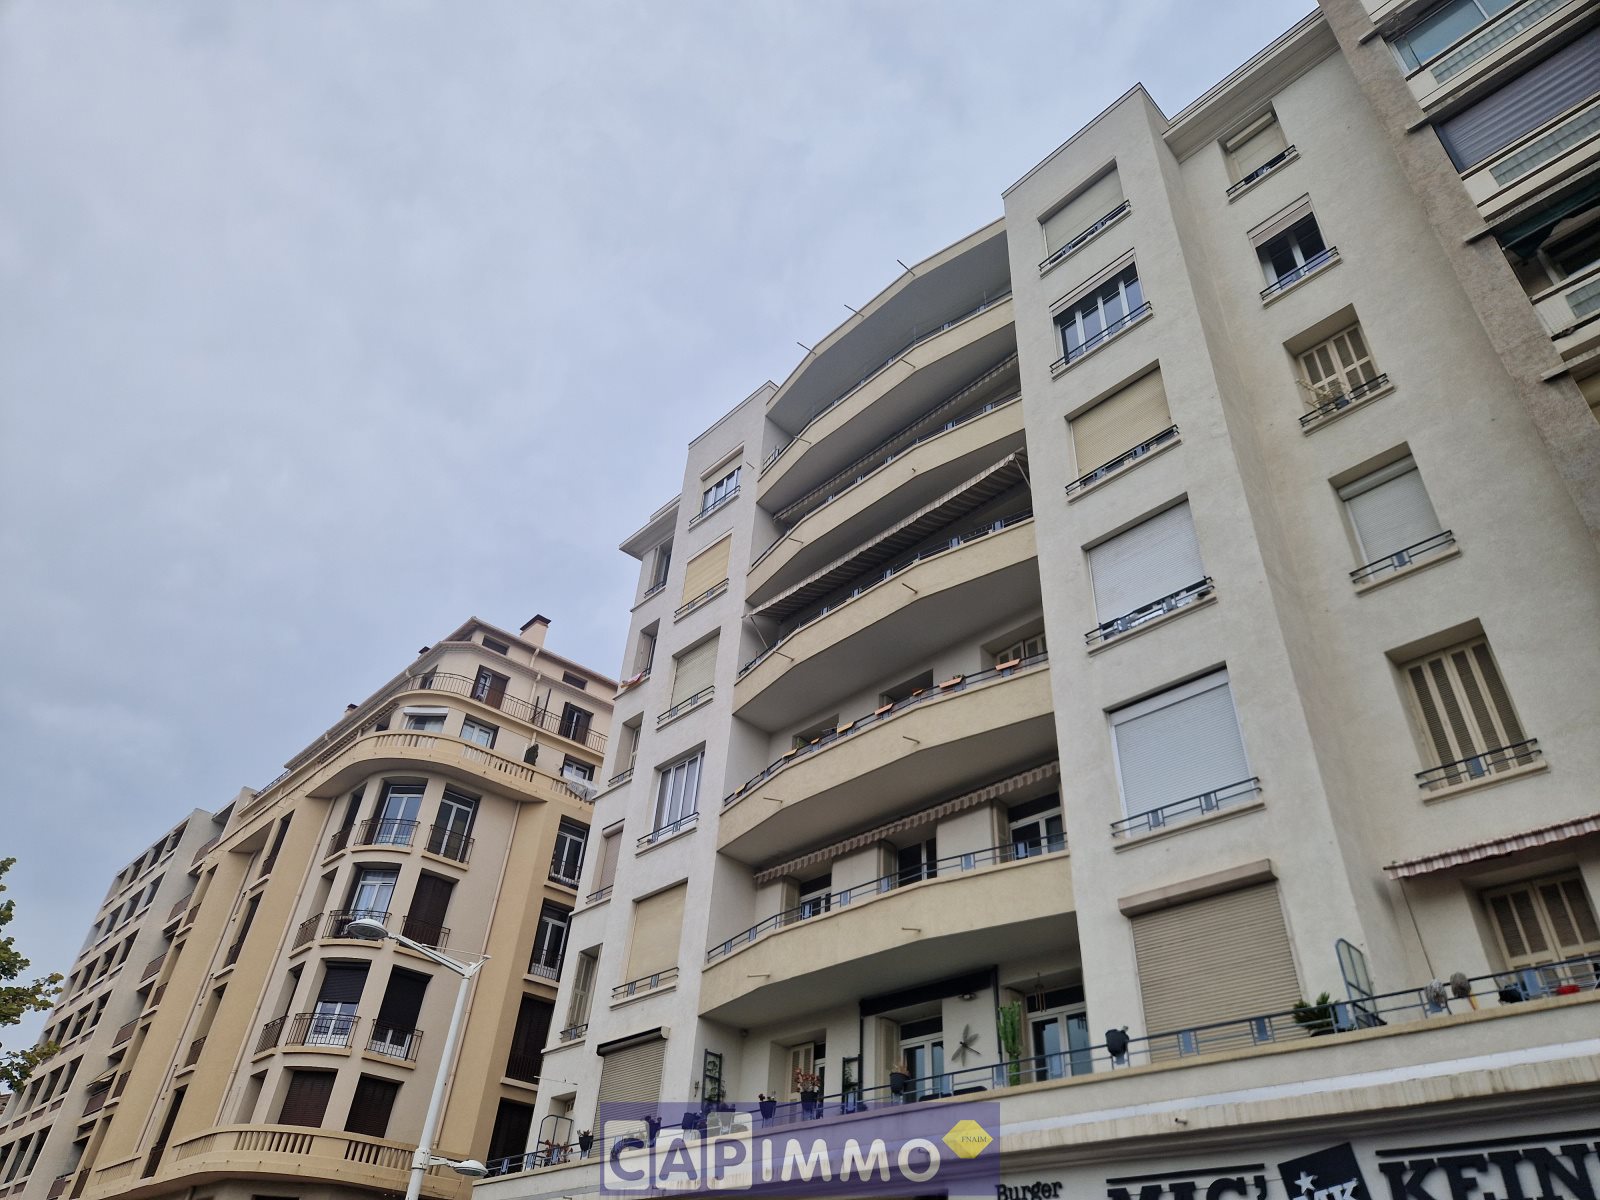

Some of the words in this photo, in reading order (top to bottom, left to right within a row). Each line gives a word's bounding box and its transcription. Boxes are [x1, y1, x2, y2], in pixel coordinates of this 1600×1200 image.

[1107, 1175, 1267, 1200] IC'
[1378, 1142, 1600, 1200] KEIN
[995, 1181, 1063, 1200] Burger
